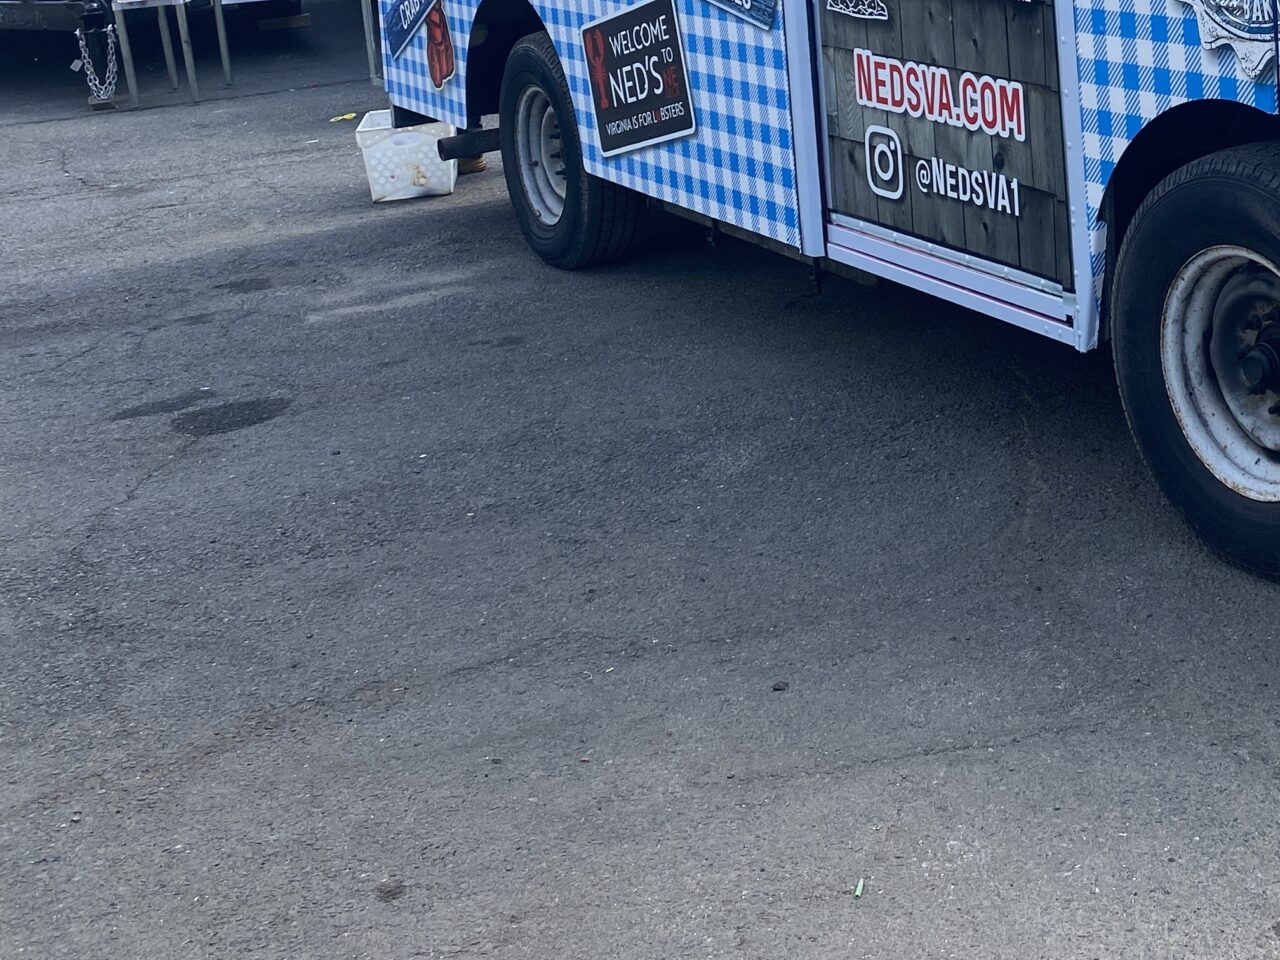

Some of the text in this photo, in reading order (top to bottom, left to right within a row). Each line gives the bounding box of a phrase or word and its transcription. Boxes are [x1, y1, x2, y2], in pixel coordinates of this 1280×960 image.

[608, 14, 669, 58] WELCOME
[661, 46, 673, 63] TO
[608, 55, 664, 108] NED'S
[855, 51, 1024, 139] NEDSVA.COM
[605, 117, 632, 136] VIRGINIA
[631, 115, 639, 129] IS
[638, 111, 653, 127] FOR
[915, 156, 1020, 217] @NEDSVA1
